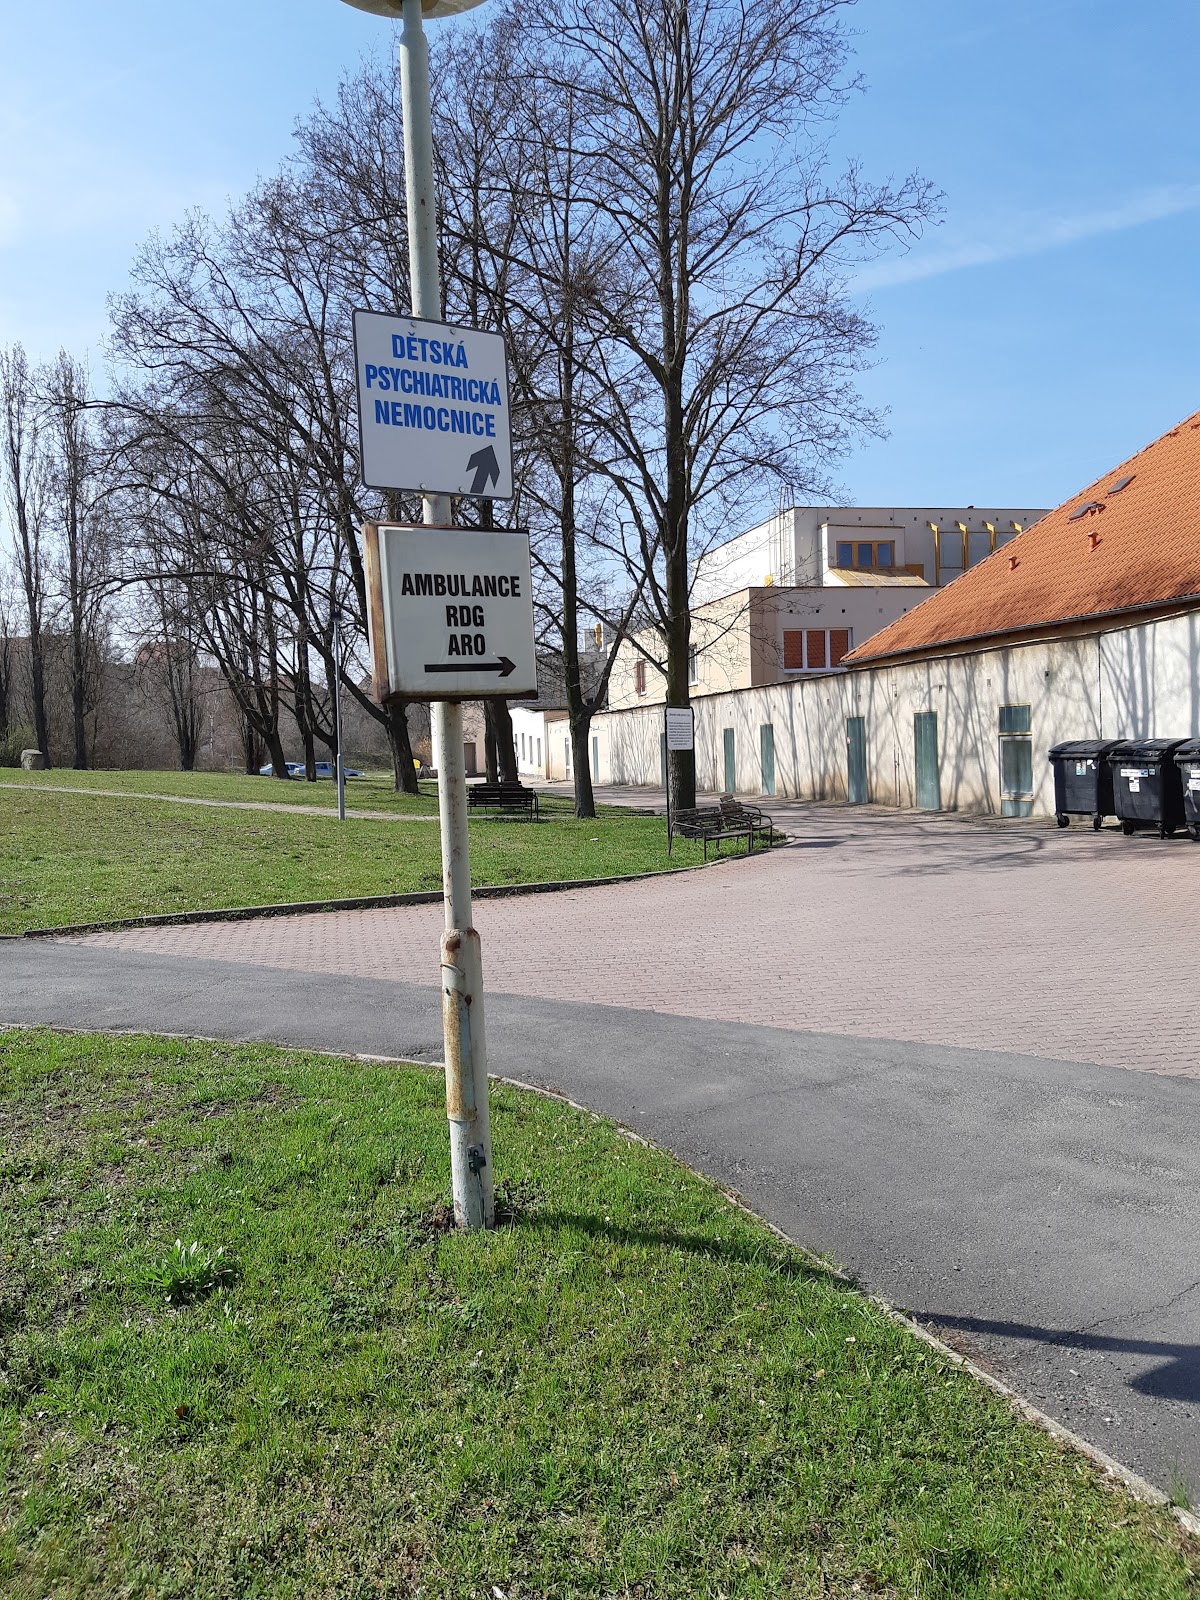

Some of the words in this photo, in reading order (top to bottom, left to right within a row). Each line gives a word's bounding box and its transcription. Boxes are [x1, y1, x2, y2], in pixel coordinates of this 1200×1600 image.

[392, 331, 468, 368] DĚTSKÁ
[365, 364, 501, 406] PSYCHIATRICKÁ
[374, 400, 496, 437] NEMOCNICE
[401, 573, 521, 597] AMBULANCE
[446, 605, 485, 627] RDG
[448, 633, 485, 656] ARO
